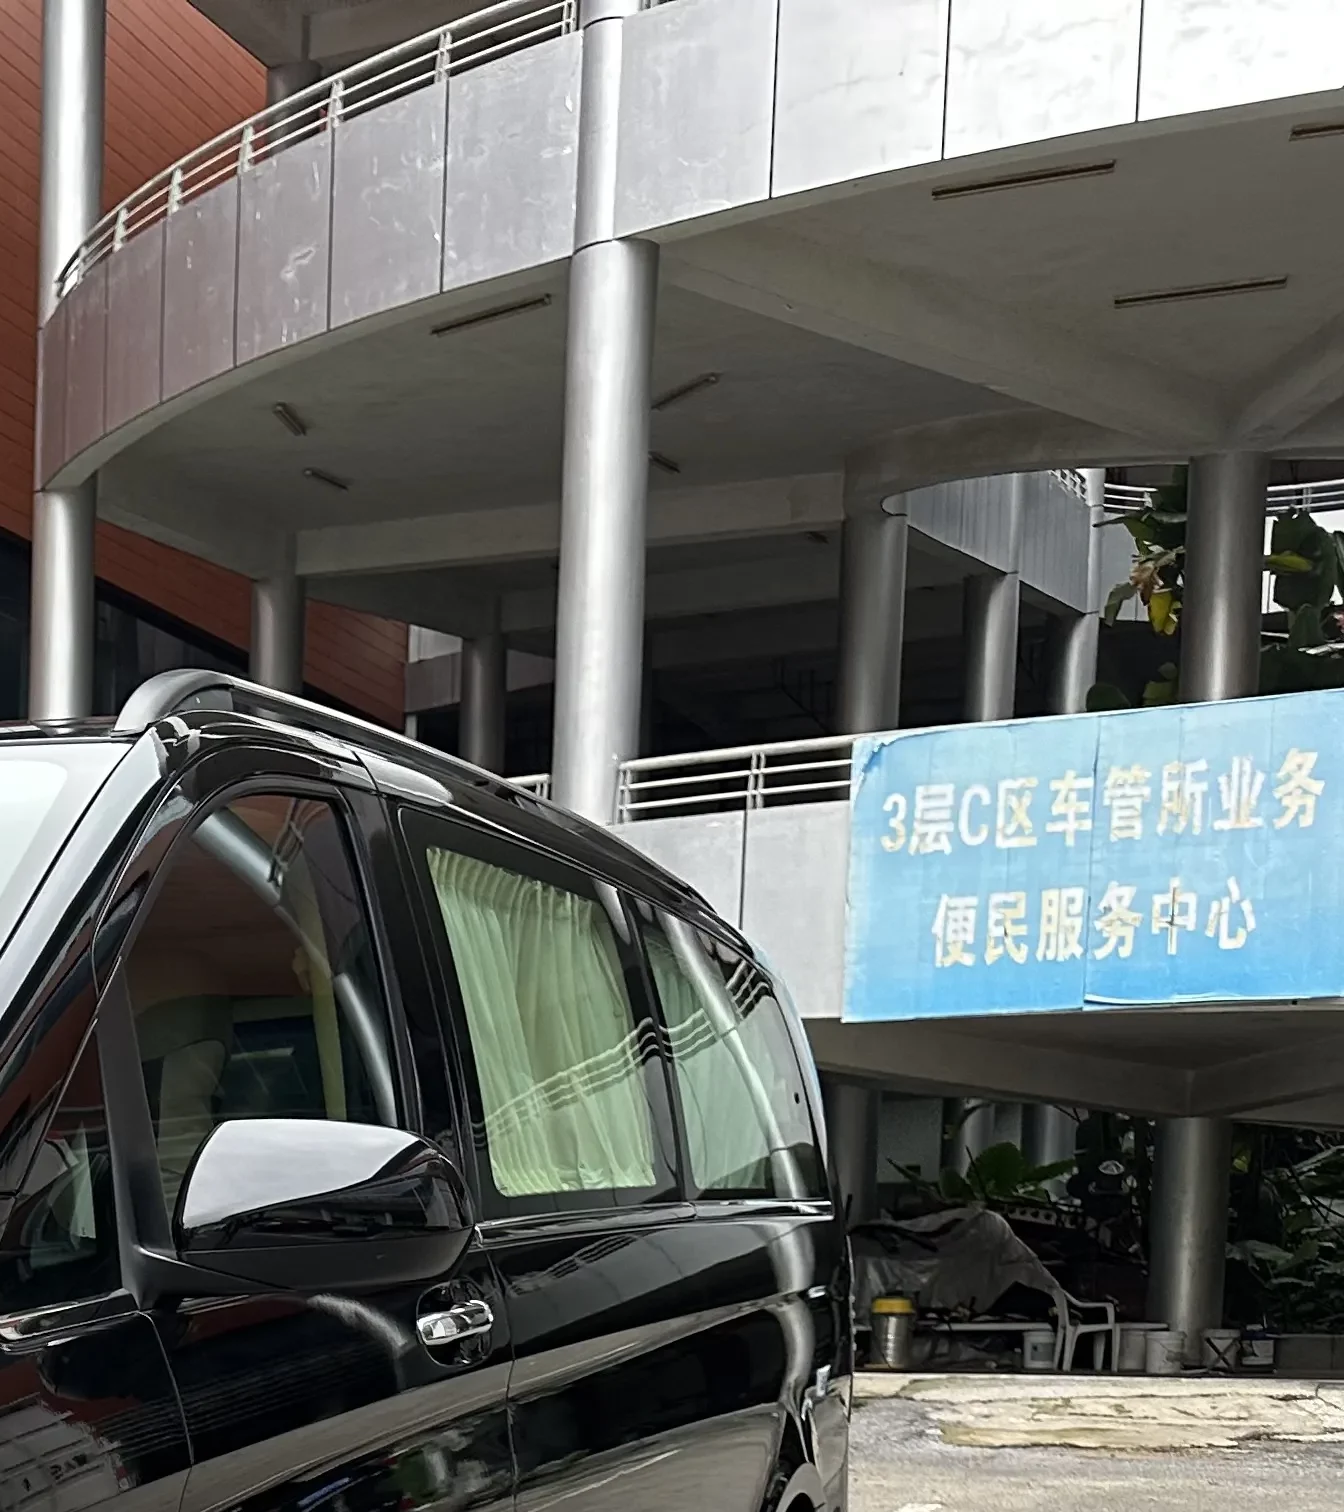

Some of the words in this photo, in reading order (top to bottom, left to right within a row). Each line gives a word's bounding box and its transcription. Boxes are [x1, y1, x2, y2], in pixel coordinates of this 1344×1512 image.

[880, 747, 1326, 857] 3层C区车管所业务
[931, 877, 1256, 968] 便民服务中心
